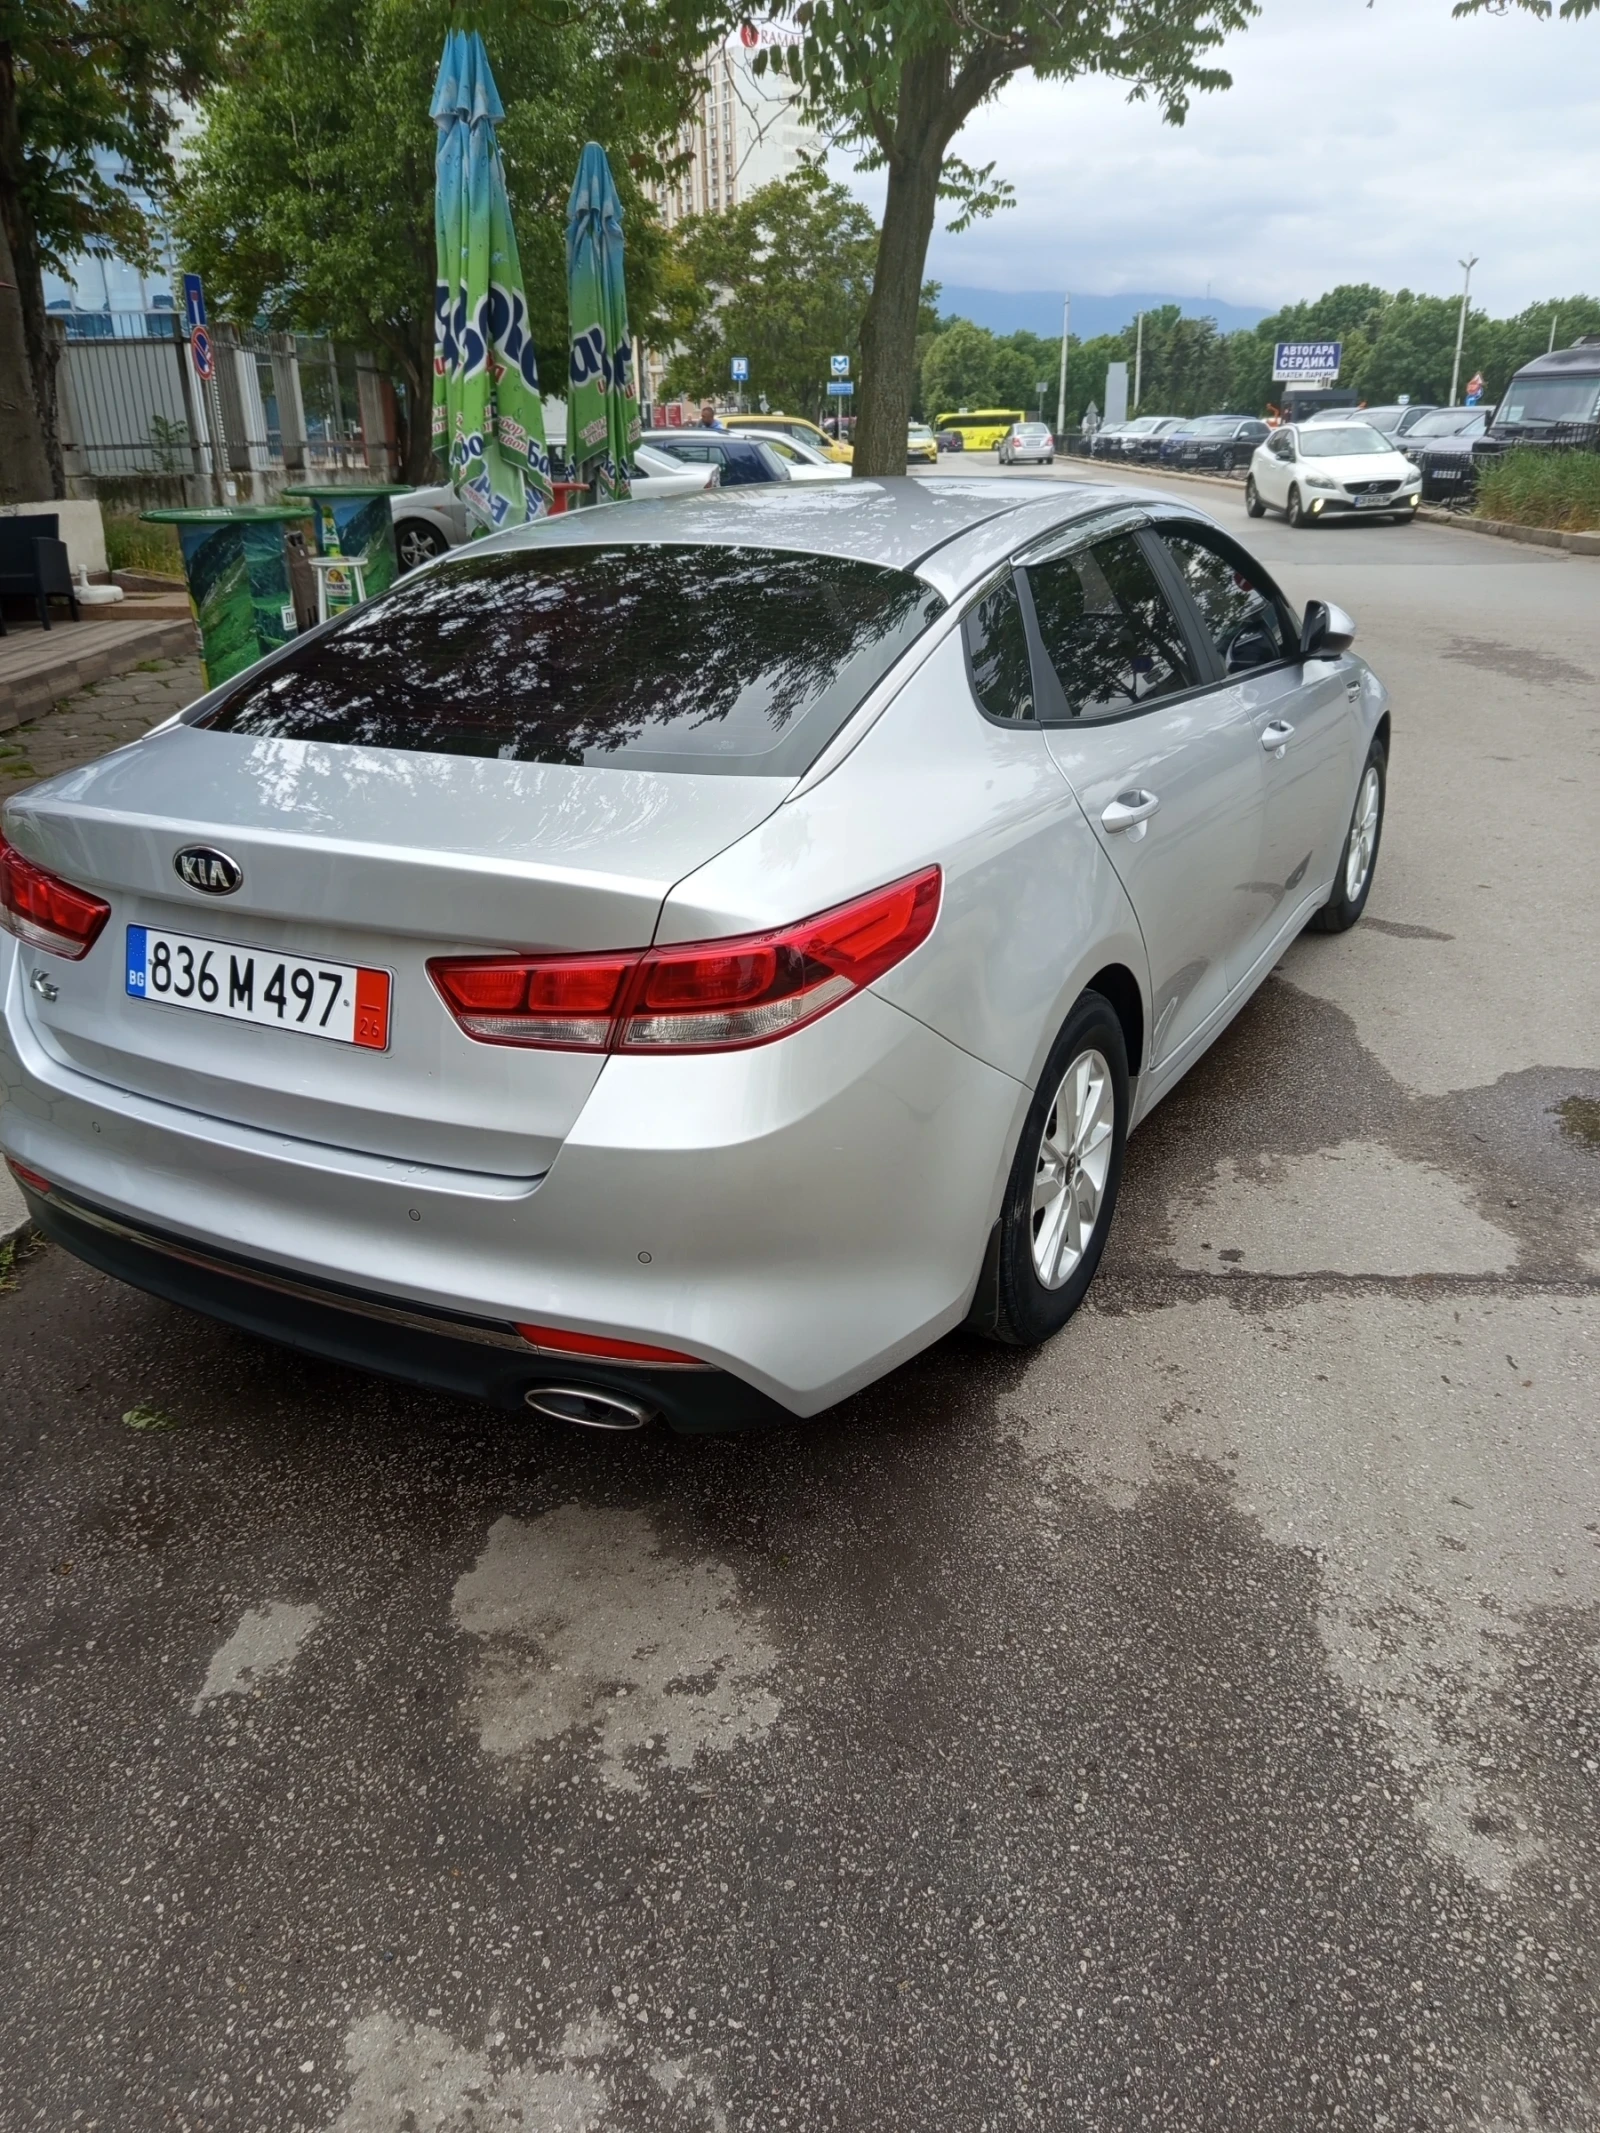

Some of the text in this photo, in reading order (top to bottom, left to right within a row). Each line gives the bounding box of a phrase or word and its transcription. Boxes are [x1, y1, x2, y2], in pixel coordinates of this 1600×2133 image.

[1282, 345, 1335, 356] АВТОГАРА
[1280, 356, 1335, 369] СЕРДИКА
[1276, 371, 1303, 379] ПЛАТЕН
[181, 855, 229, 888] KIA
[129, 969, 145, 988] BG
[151, 941, 343, 1027] 836 M 497
[359, 1017, 380, 1038] 26
